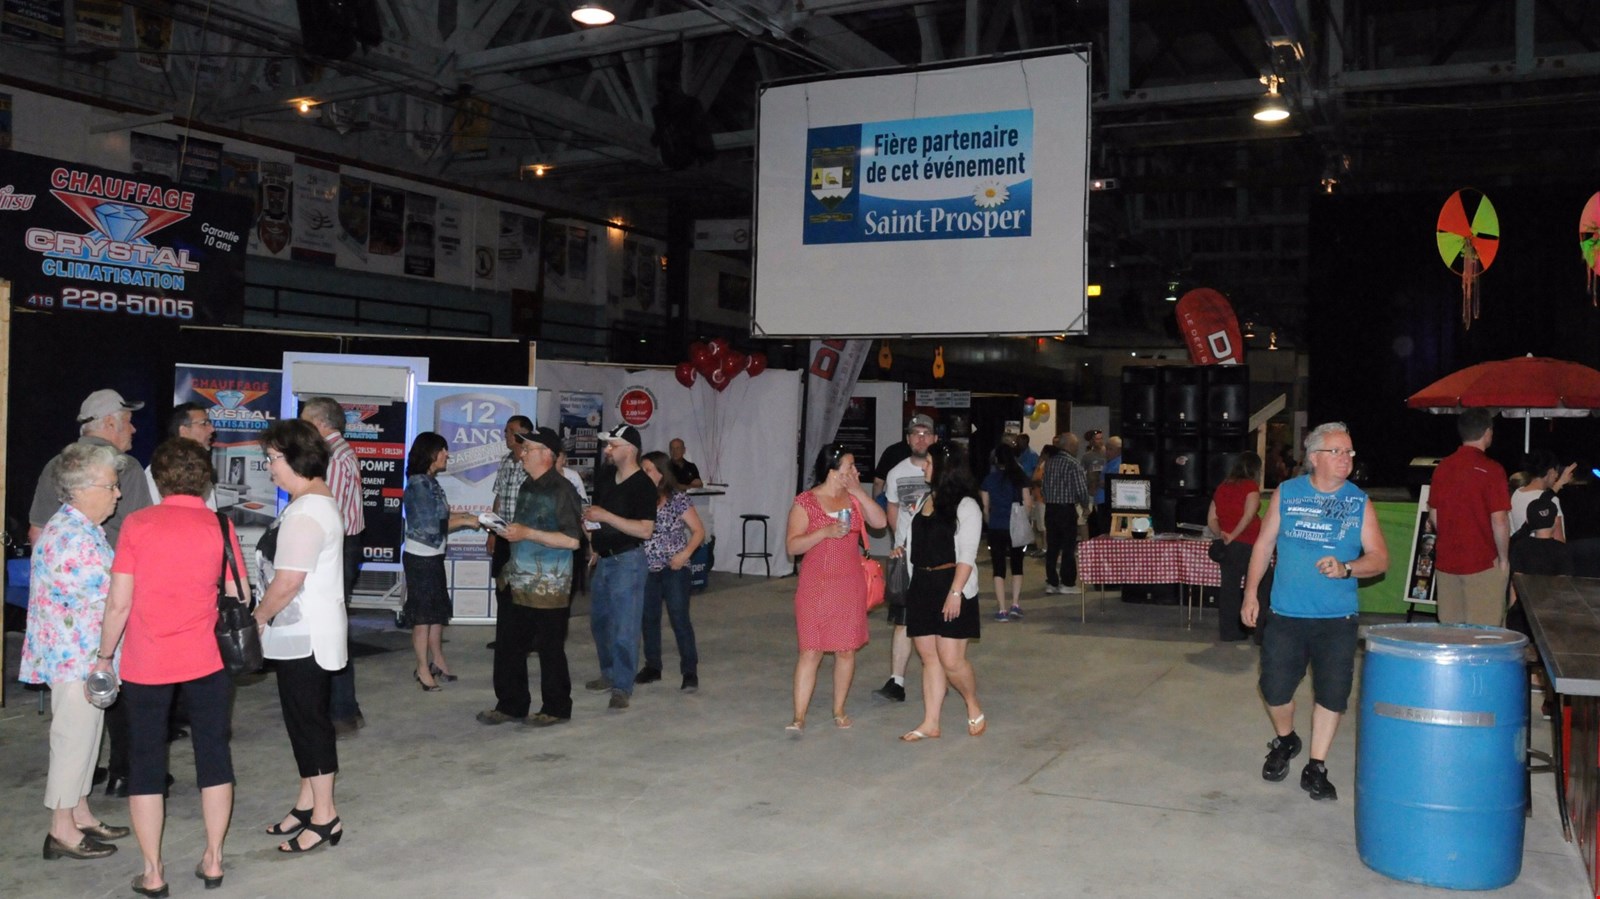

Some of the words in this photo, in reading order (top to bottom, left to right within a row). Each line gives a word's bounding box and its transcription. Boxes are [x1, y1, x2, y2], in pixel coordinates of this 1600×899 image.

[874, 133, 917, 156] Fière
[922, 125, 1018, 158] partenaire
[866, 161, 887, 183] de
[892, 159, 919, 182] cet
[923, 156, 1026, 180] événement
[50, 167, 195, 212] CHAUFFAGE
[201, 222, 239, 243] Garantie
[864, 207, 1026, 238] Saint-Prosper
[25, 227, 200, 272] CRYSTAL
[204, 235, 214, 247] 10
[215, 241, 232, 252] ans
[42, 259, 185, 291] CLIMATISATION
[62, 288, 193, 319] 228-5005
[1207, 330, 1237, 364] D
[191, 377, 271, 392] CHAUFFAGE
[206, 408, 276, 420] YSTAL
[460, 402, 496, 423] 12
[452, 428, 502, 444] ANS
[361, 460, 395, 472] POMPE
[1295, 521, 1333, 530] PRIME
[363, 547, 394, 558] 005
